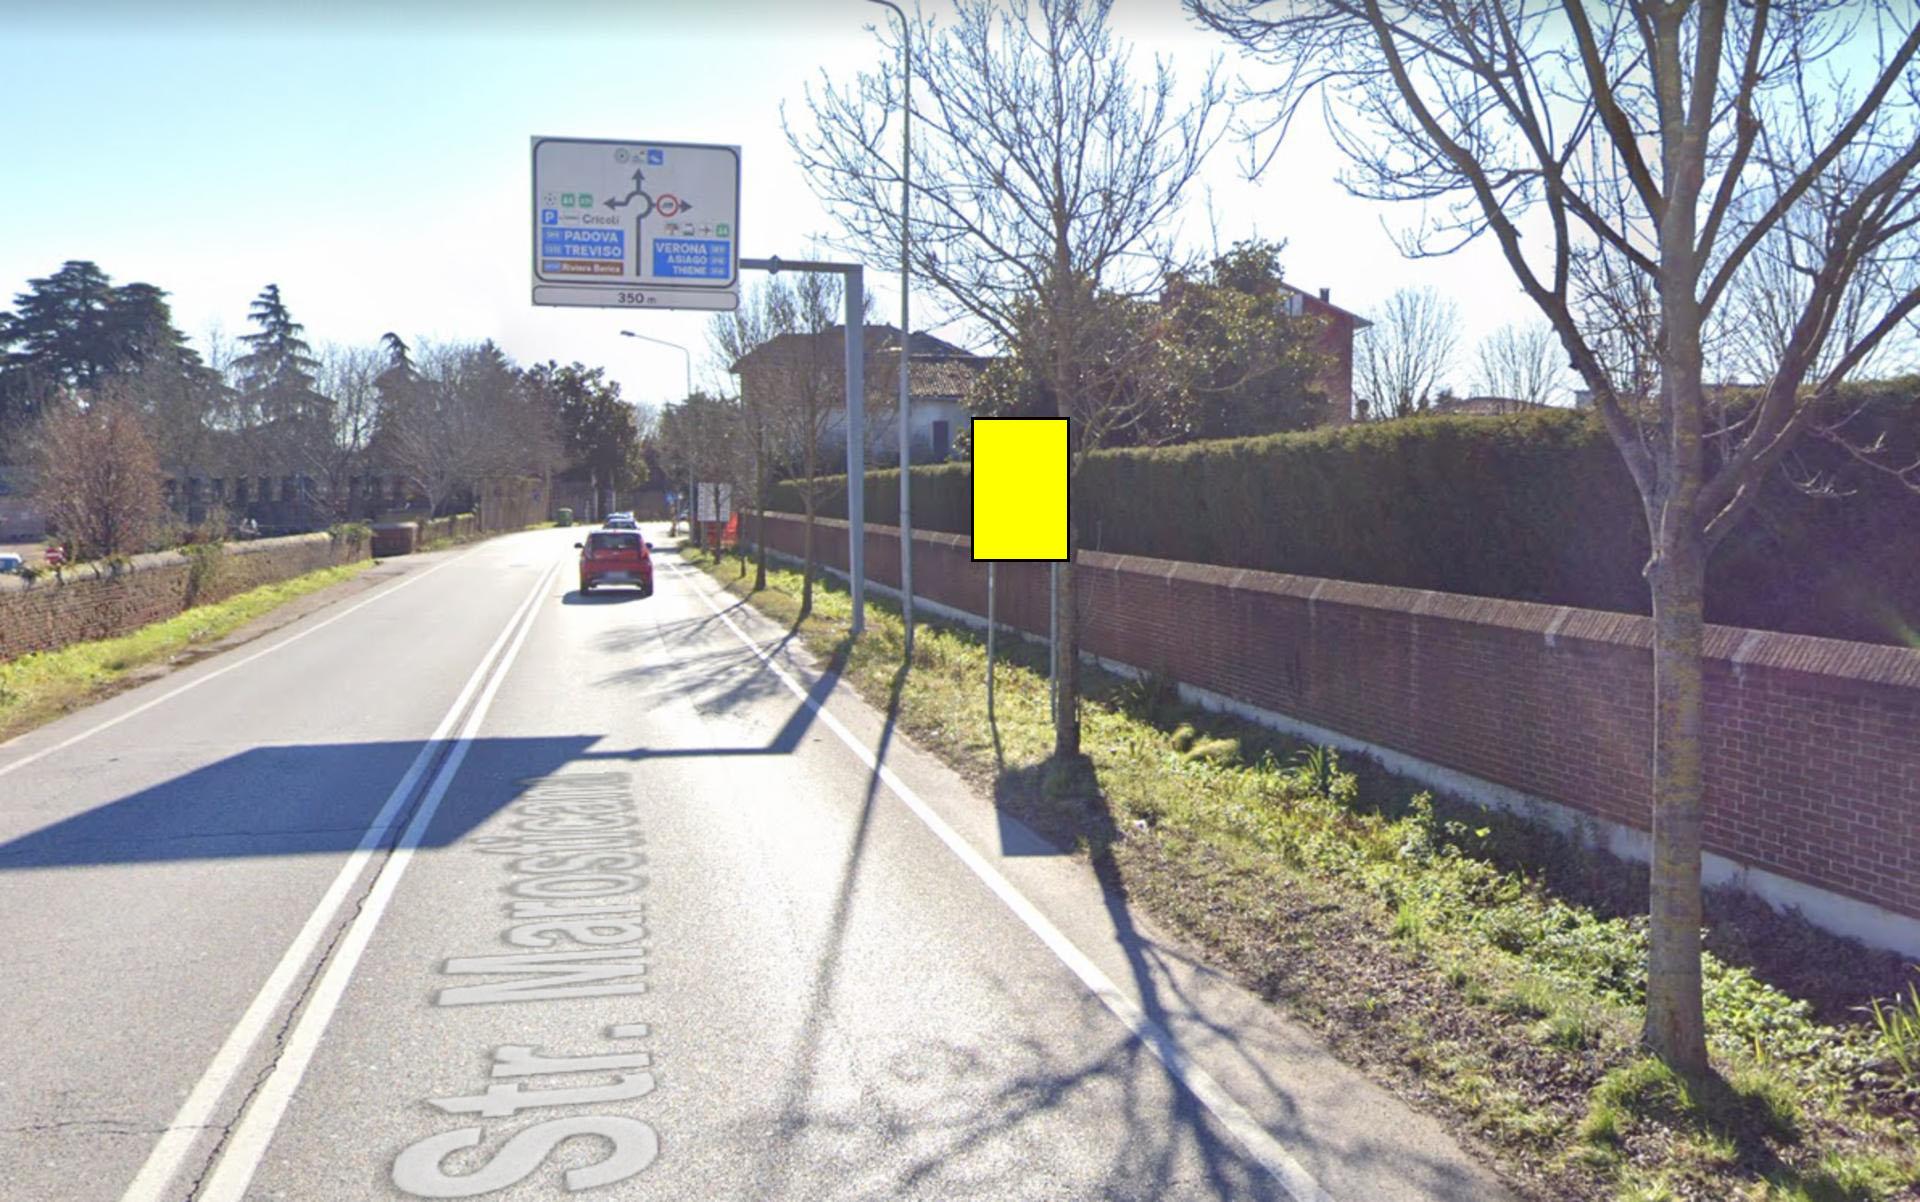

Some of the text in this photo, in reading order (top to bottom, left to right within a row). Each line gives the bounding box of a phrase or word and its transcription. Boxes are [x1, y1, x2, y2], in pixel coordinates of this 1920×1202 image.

[564, 231, 619, 243] PADOVA
[564, 244, 622, 257] TREVISO
[655, 242, 708, 254] VERONA
[667, 255, 708, 265] ASIAGO
[672, 265, 707, 276] THIENE
[617, 292, 657, 304] 350 m
